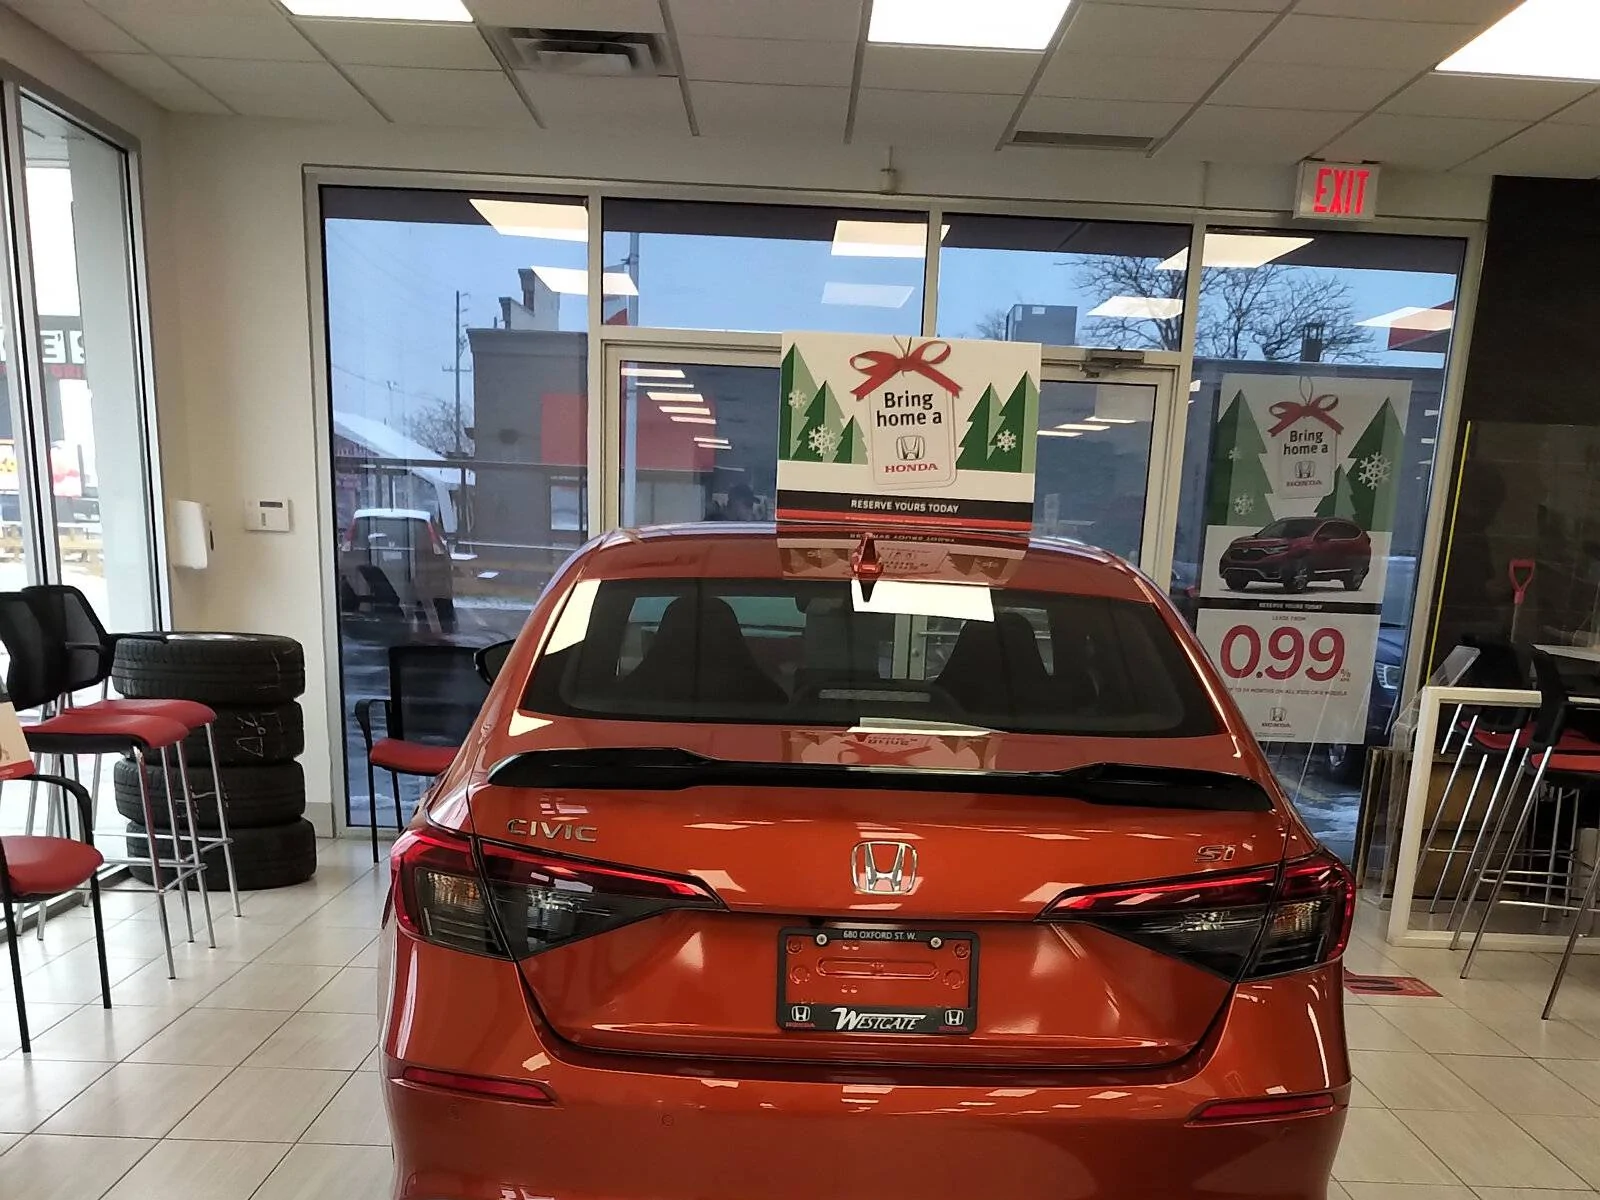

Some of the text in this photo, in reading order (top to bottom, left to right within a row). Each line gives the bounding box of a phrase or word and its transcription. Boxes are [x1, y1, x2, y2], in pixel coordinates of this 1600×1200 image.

[1313, 168, 1370, 214] EXIT
[884, 390, 933, 410] Bring
[876, 410, 942, 427] home a
[1290, 430, 1323, 443] Bring
[1283, 444, 1328, 455] home a
[885, 463, 938, 473] HONDA
[851, 499, 959, 513] RESERVE YOURS TODAY
[1220, 624, 1345, 682] 0.99
[506, 818, 598, 842] CIVIC
[843, 930, 858, 939] 680
[859, 930, 893, 940] OXFORD
[830, 1007, 927, 1032] WESTGATE
